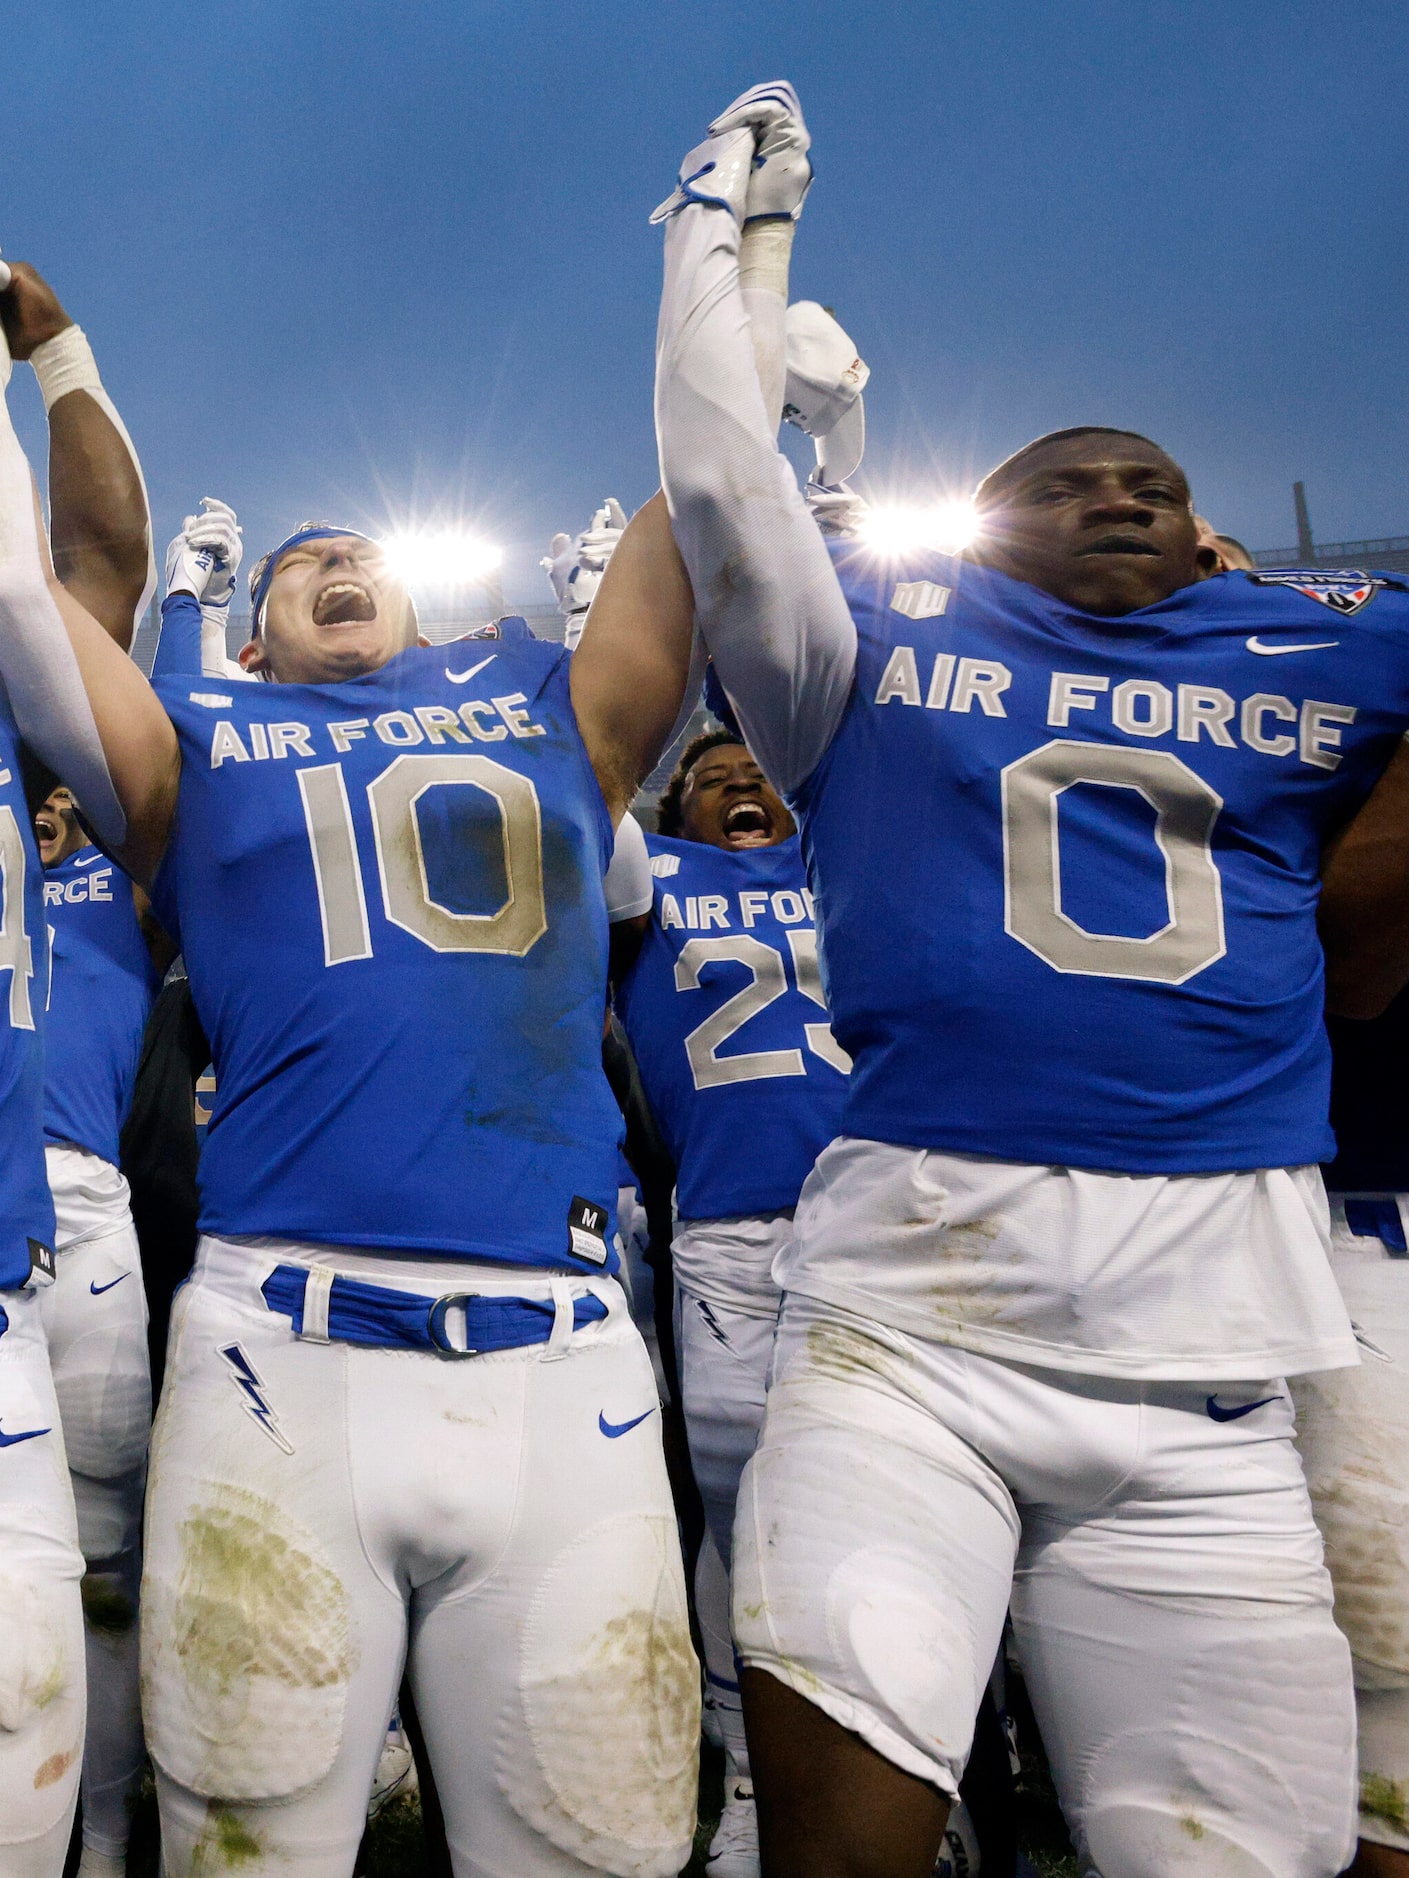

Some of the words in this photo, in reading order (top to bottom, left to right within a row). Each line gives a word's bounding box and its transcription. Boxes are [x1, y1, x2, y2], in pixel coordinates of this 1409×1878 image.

[211, 721, 315, 768] AIR
[327, 692, 546, 753] FORCE
[875, 646, 1012, 718] AIR
[1047, 671, 1357, 771] FORCE
[296, 753, 549, 968] 10
[1001, 739, 1227, 985] 0
[662, 894, 731, 930] AIR
[674, 929, 854, 1090] 25
[40, 1248, 50, 1269] M
[582, 1208, 598, 1229] M
